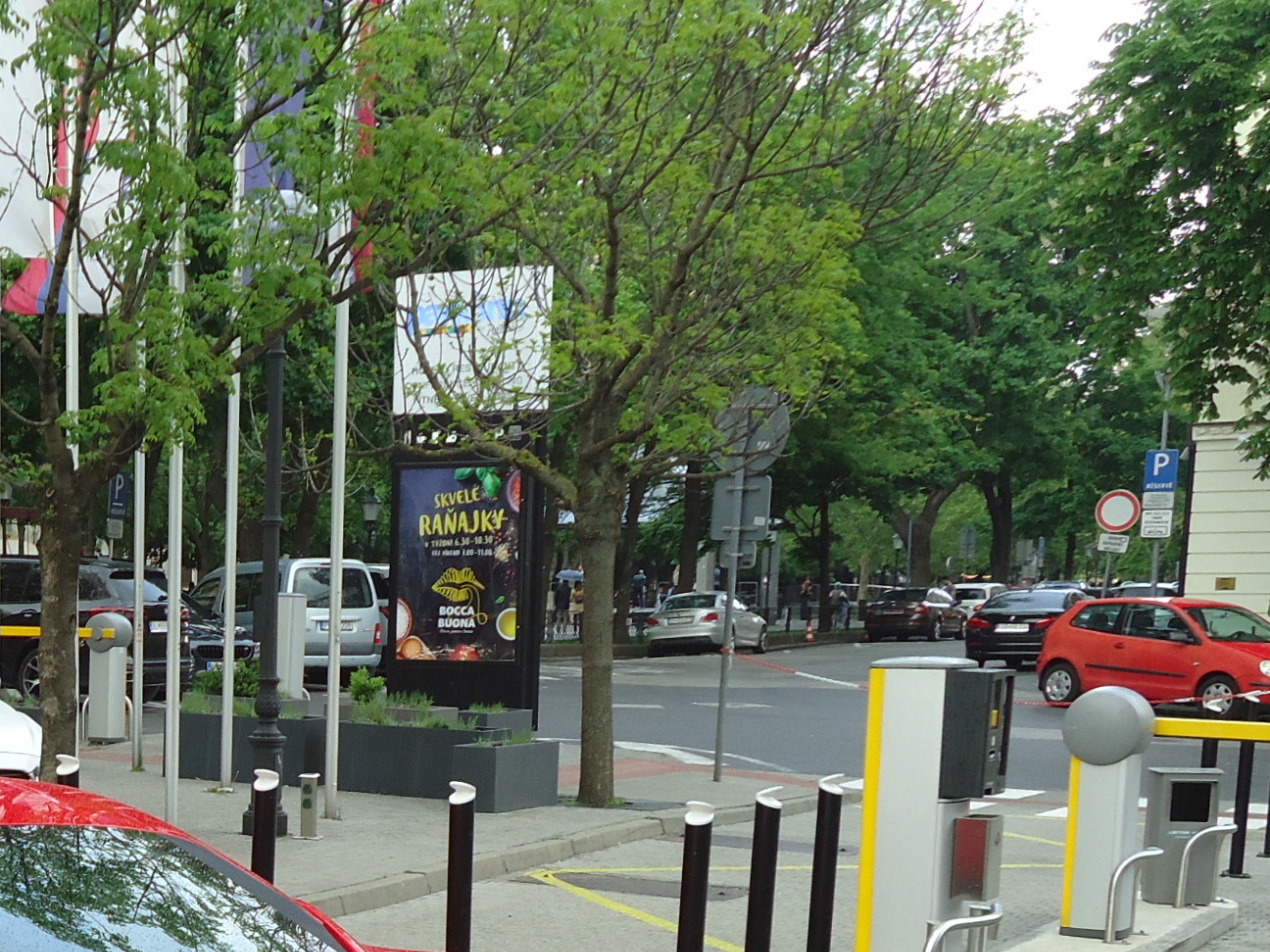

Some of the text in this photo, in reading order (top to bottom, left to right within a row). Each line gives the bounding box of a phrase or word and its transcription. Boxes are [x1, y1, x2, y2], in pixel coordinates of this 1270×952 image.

[1153, 453, 1170, 476] P
[115, 474, 125, 500] P
[419, 507, 506, 536] RAŇAJKY
[439, 605, 476, 616] BOCCA
[437, 617, 476, 628] BUONA
